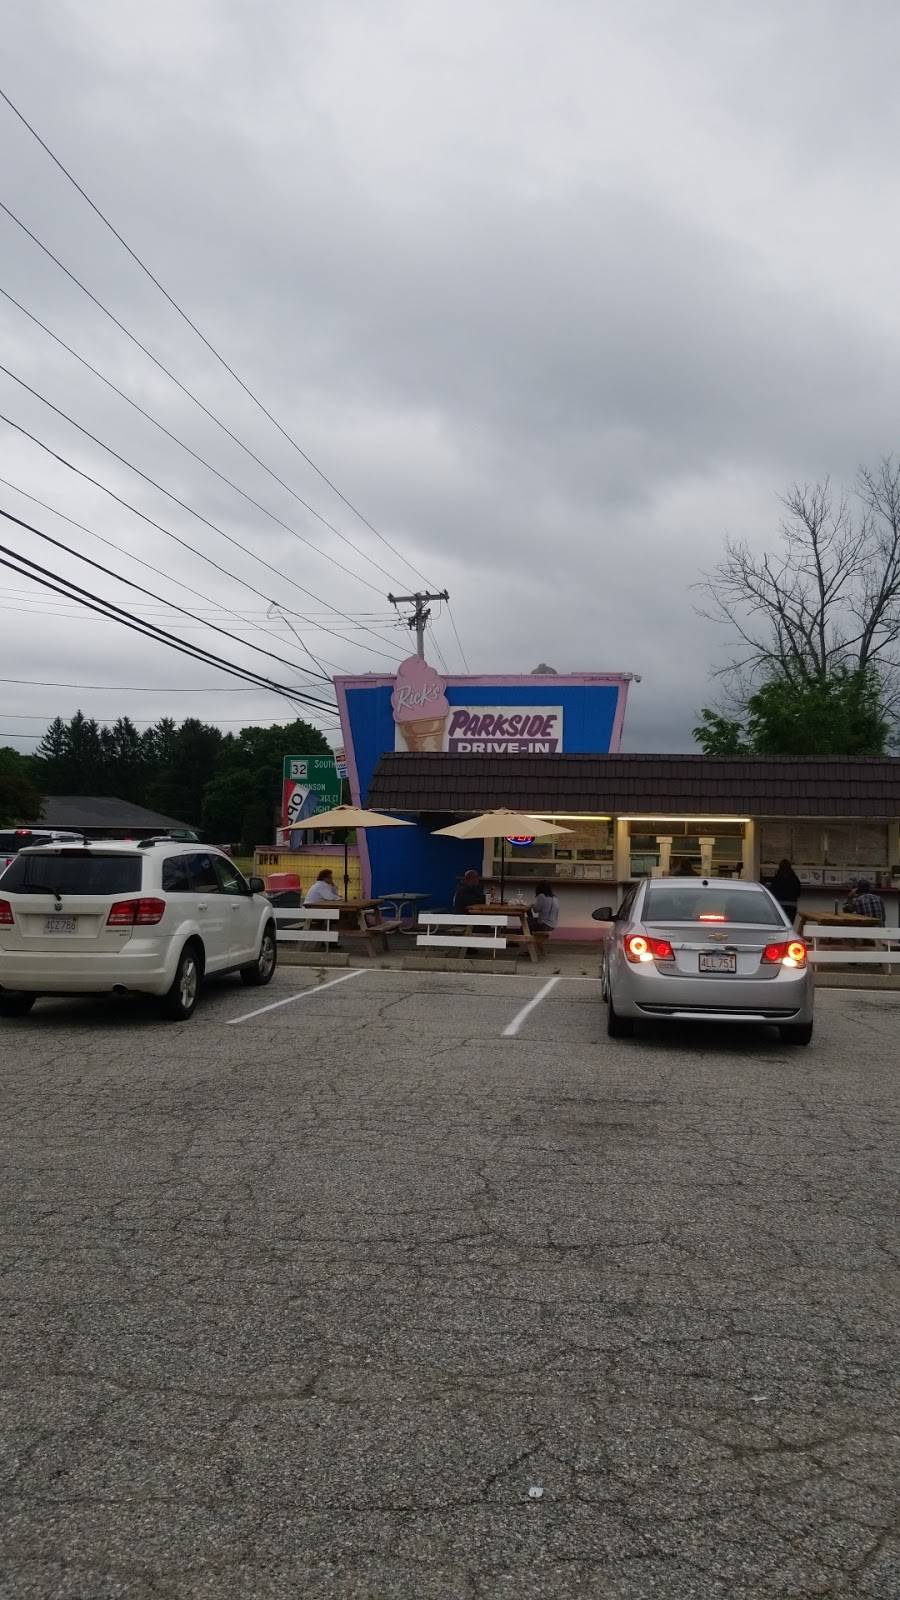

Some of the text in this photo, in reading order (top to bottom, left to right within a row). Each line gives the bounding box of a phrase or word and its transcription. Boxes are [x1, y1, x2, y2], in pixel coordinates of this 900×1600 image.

[395, 683, 440, 713] Rick's
[448, 709, 557, 737] PARKSIDE
[457, 742, 550, 753] DRIVE-IN
[292, 764, 307, 775] 32
[259, 854, 279, 865] OPEN
